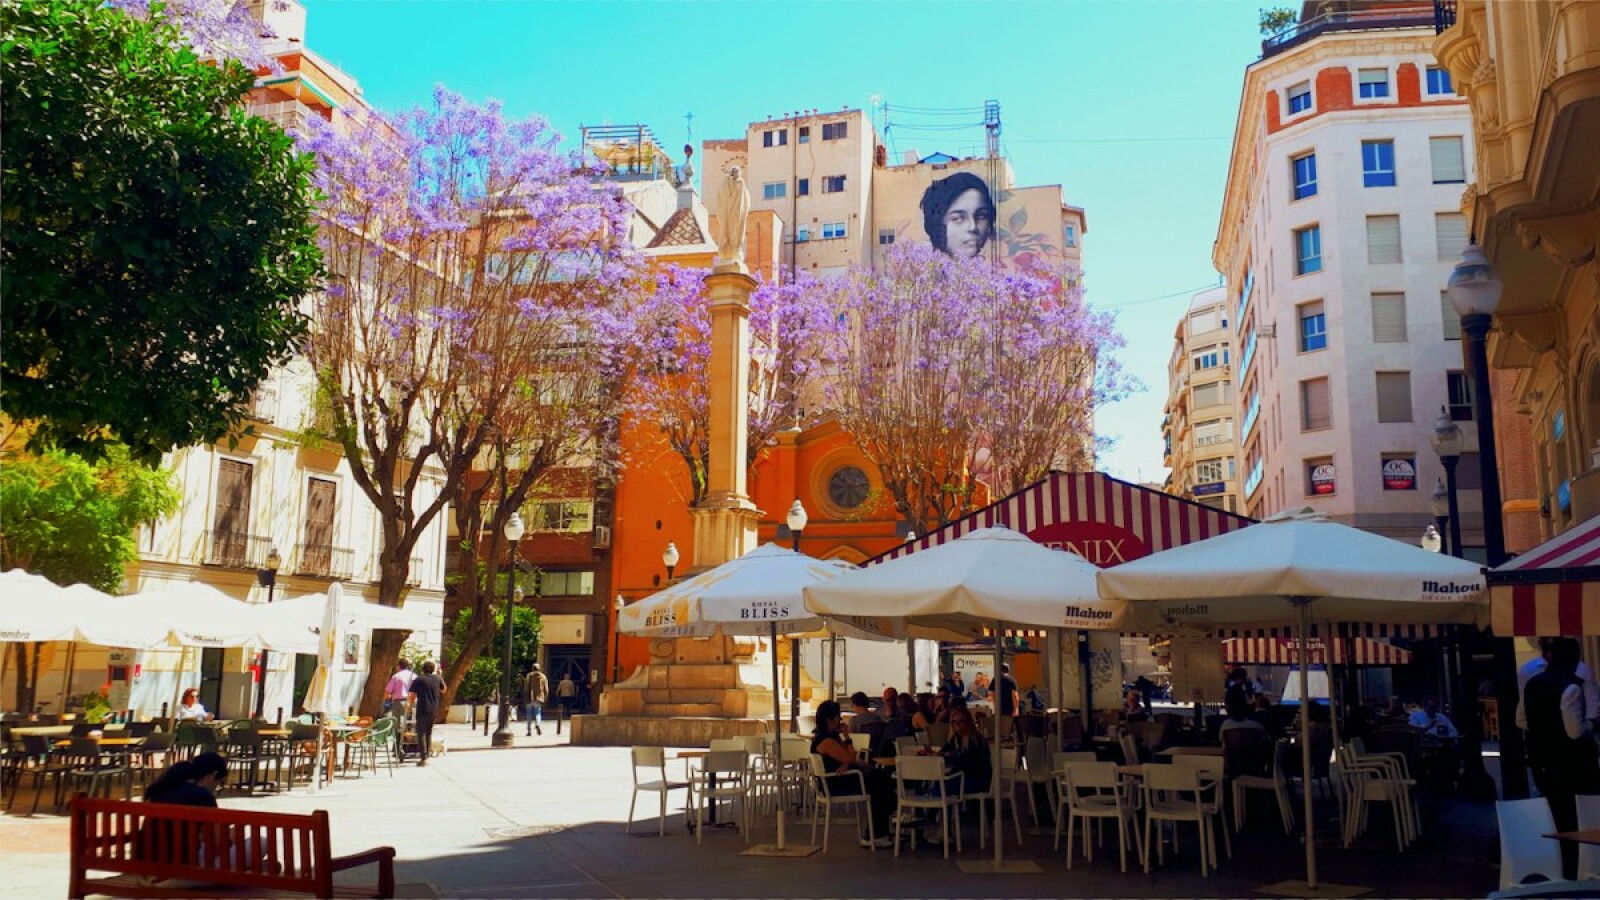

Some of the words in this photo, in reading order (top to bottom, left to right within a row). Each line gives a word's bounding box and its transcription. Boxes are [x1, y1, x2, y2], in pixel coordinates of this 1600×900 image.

[1422, 580, 1480, 593] Mahou
[740, 607, 789, 619] BLISS
[1065, 605, 1113, 619] Mahou
[645, 613, 677, 627] BLISS
